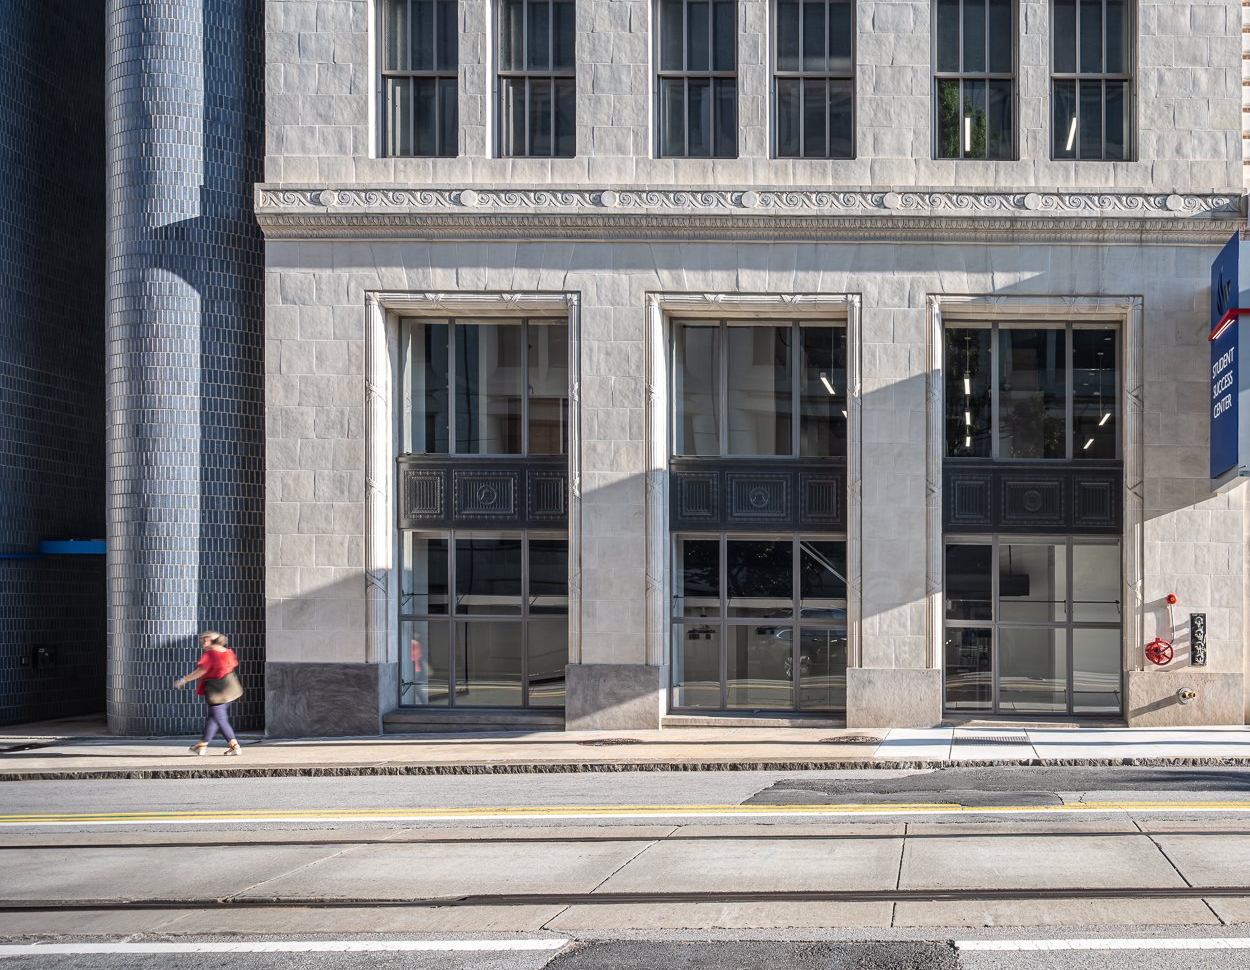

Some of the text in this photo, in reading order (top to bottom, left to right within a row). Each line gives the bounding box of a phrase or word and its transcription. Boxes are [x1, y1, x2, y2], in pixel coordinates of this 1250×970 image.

[1212, 346, 1235, 379] STUDENT
[1213, 370, 1233, 399] SUCCESS
[1213, 393, 1232, 418] CENTER
